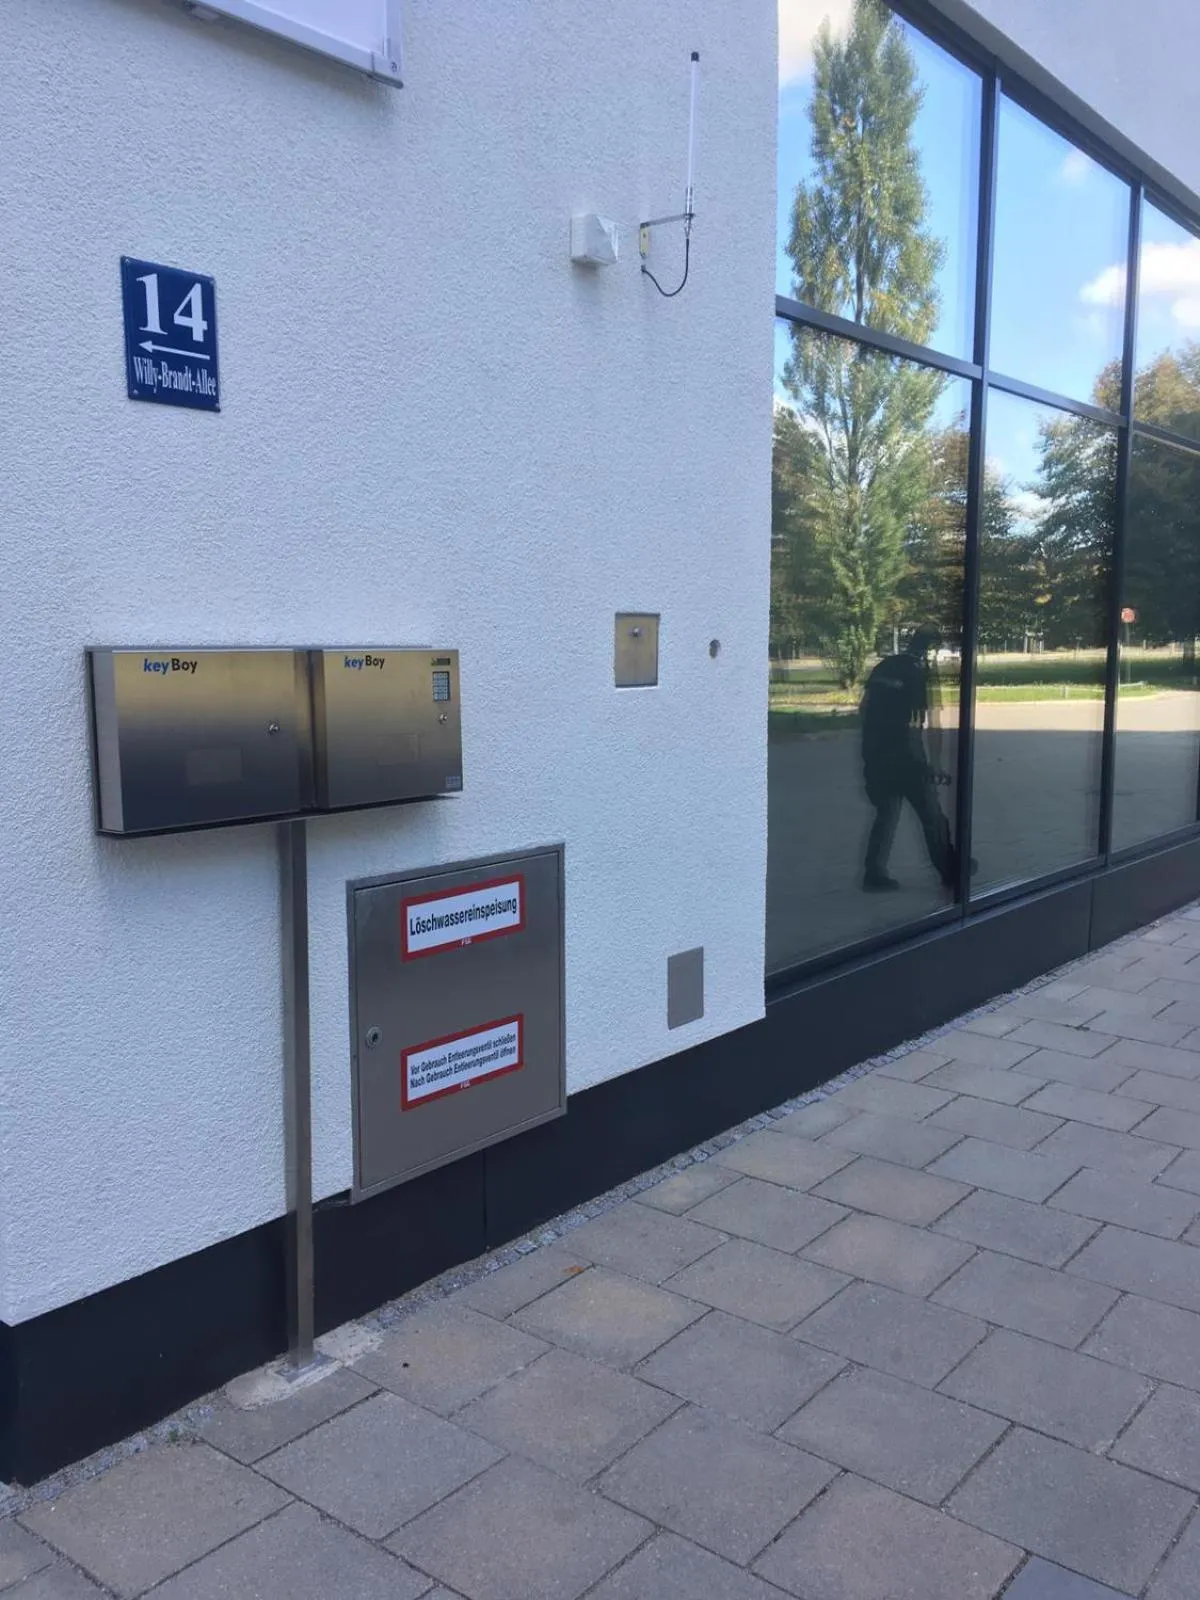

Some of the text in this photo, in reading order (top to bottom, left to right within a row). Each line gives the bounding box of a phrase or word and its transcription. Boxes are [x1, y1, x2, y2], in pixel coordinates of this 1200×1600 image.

[136, 273, 208, 342] 14
[133, 356, 216, 396] Willy-Brandt-Allee
[410, 898, 517, 936] Löschwassereinspeisung
[410, 1045, 517, 1089] Nach Gebrauch Entleerungsventil öffnen
[411, 1032, 517, 1076] Vor Gebrauch Entleerungsventil schließen
